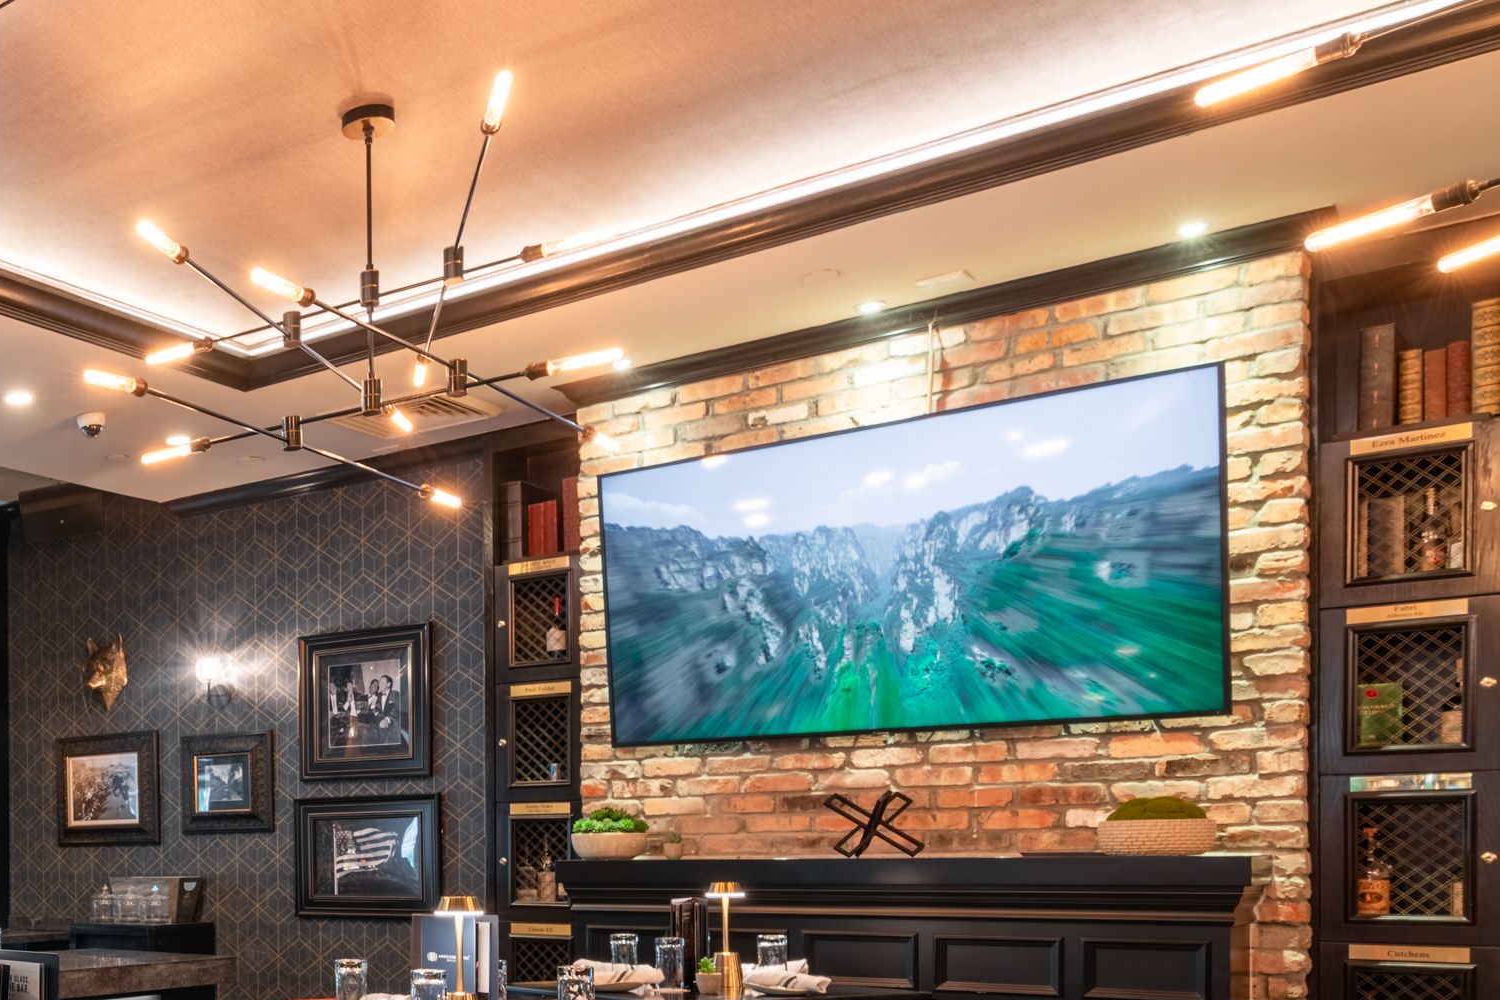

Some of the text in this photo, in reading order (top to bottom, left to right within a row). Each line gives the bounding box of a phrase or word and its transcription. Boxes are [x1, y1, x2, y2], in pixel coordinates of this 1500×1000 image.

[1371, 432, 1446, 448] Ezra Martinez
[1387, 950, 1430, 958] Cutchens
